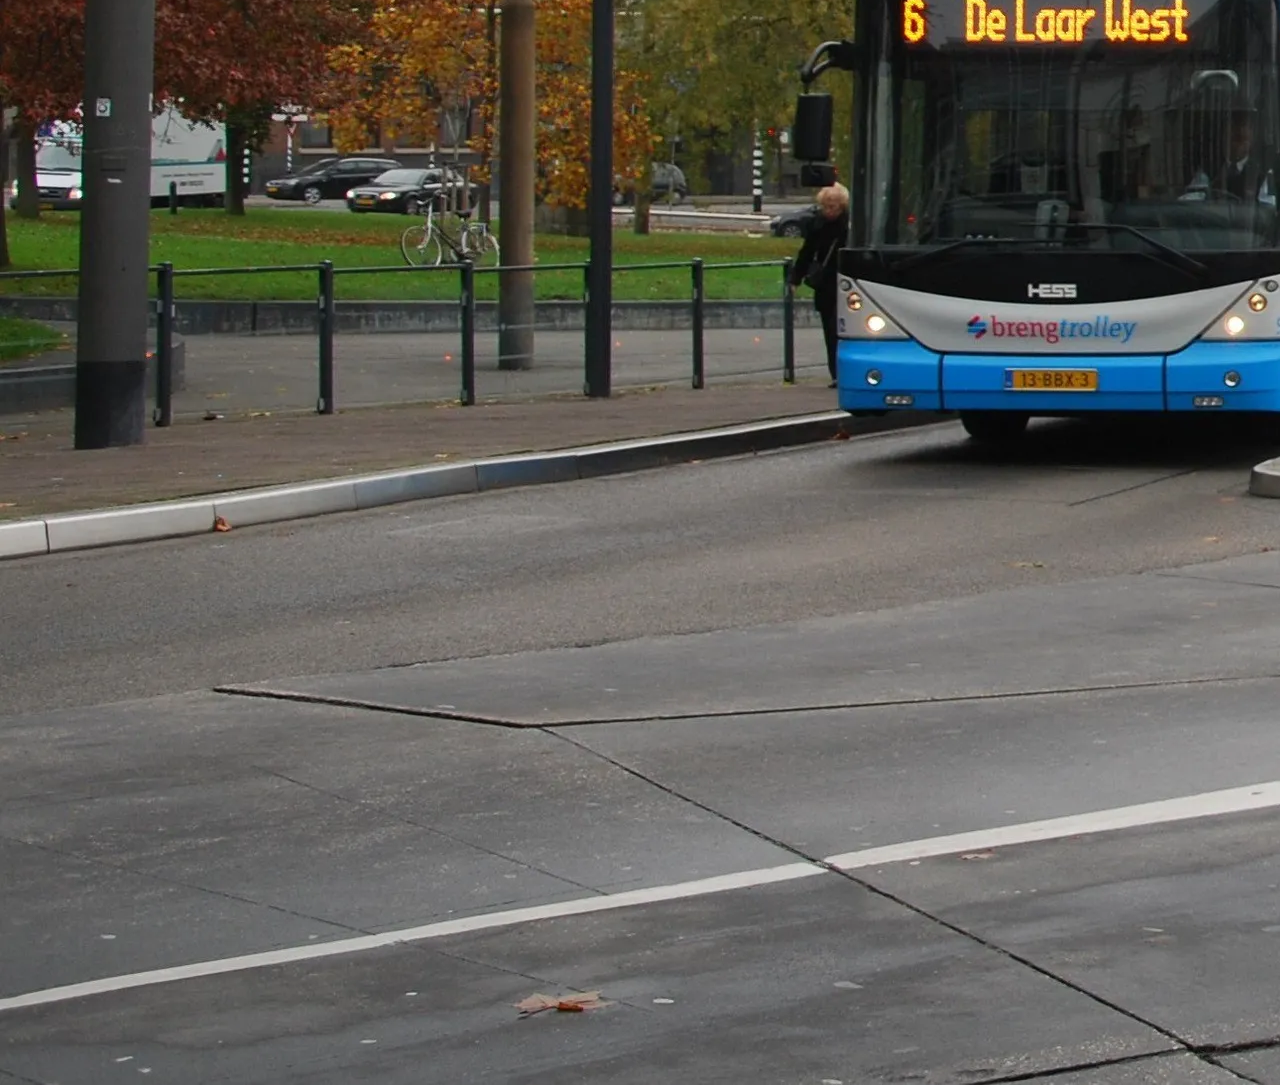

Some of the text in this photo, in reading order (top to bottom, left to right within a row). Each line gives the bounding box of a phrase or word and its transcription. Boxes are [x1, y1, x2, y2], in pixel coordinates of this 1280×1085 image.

[1027, 283, 1077, 298] HESS
[991, 315, 1137, 344] brengtrolley
[1020, 372, 1089, 388] 13-BBX-3
